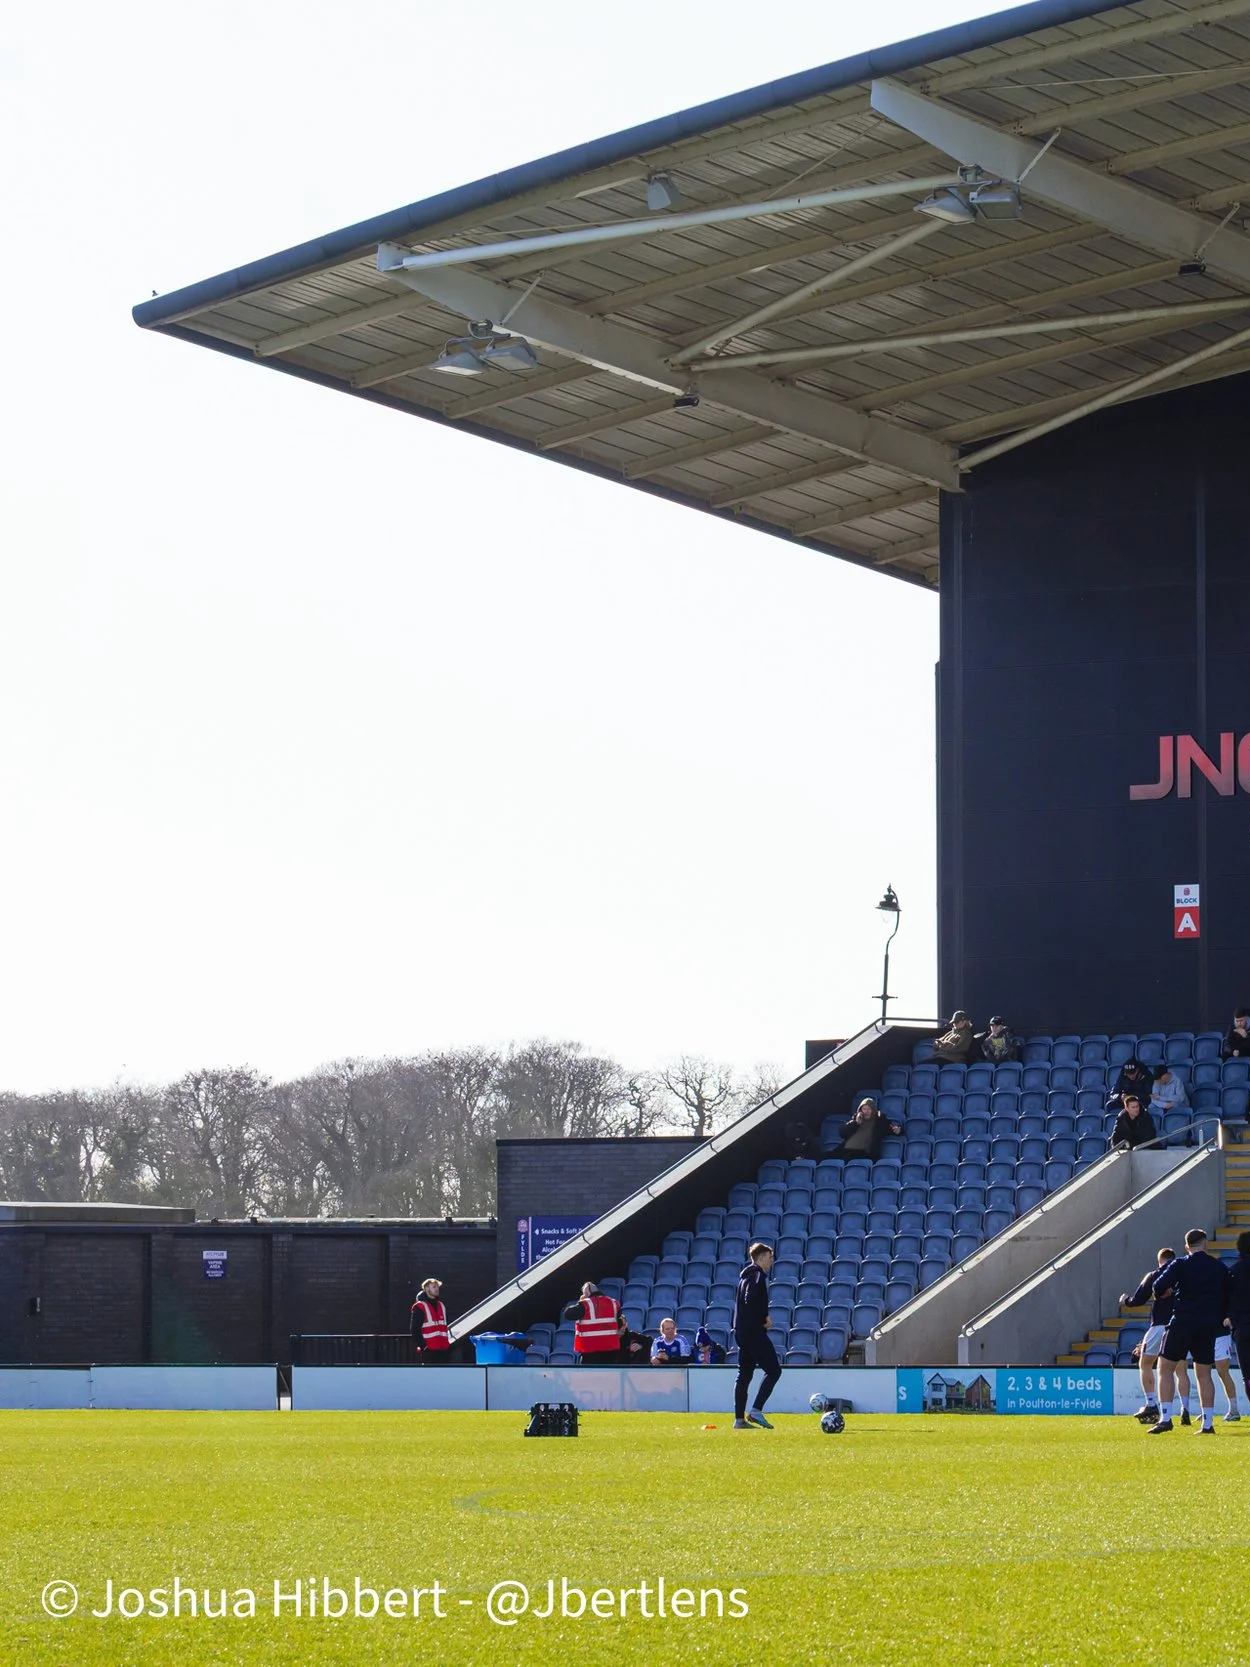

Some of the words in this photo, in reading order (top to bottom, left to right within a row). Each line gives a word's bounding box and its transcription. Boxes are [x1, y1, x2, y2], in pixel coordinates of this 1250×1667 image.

[1178, 912, 1197, 933] A
[1025, 1376, 1033, 1390] 3
[1039, 1376, 1047, 1390] &
[1053, 1376, 1062, 1390] 4
[1067, 1376, 1102, 1391] beds
[1019, 1398, 1103, 1410] Poulton-le-Fylde
